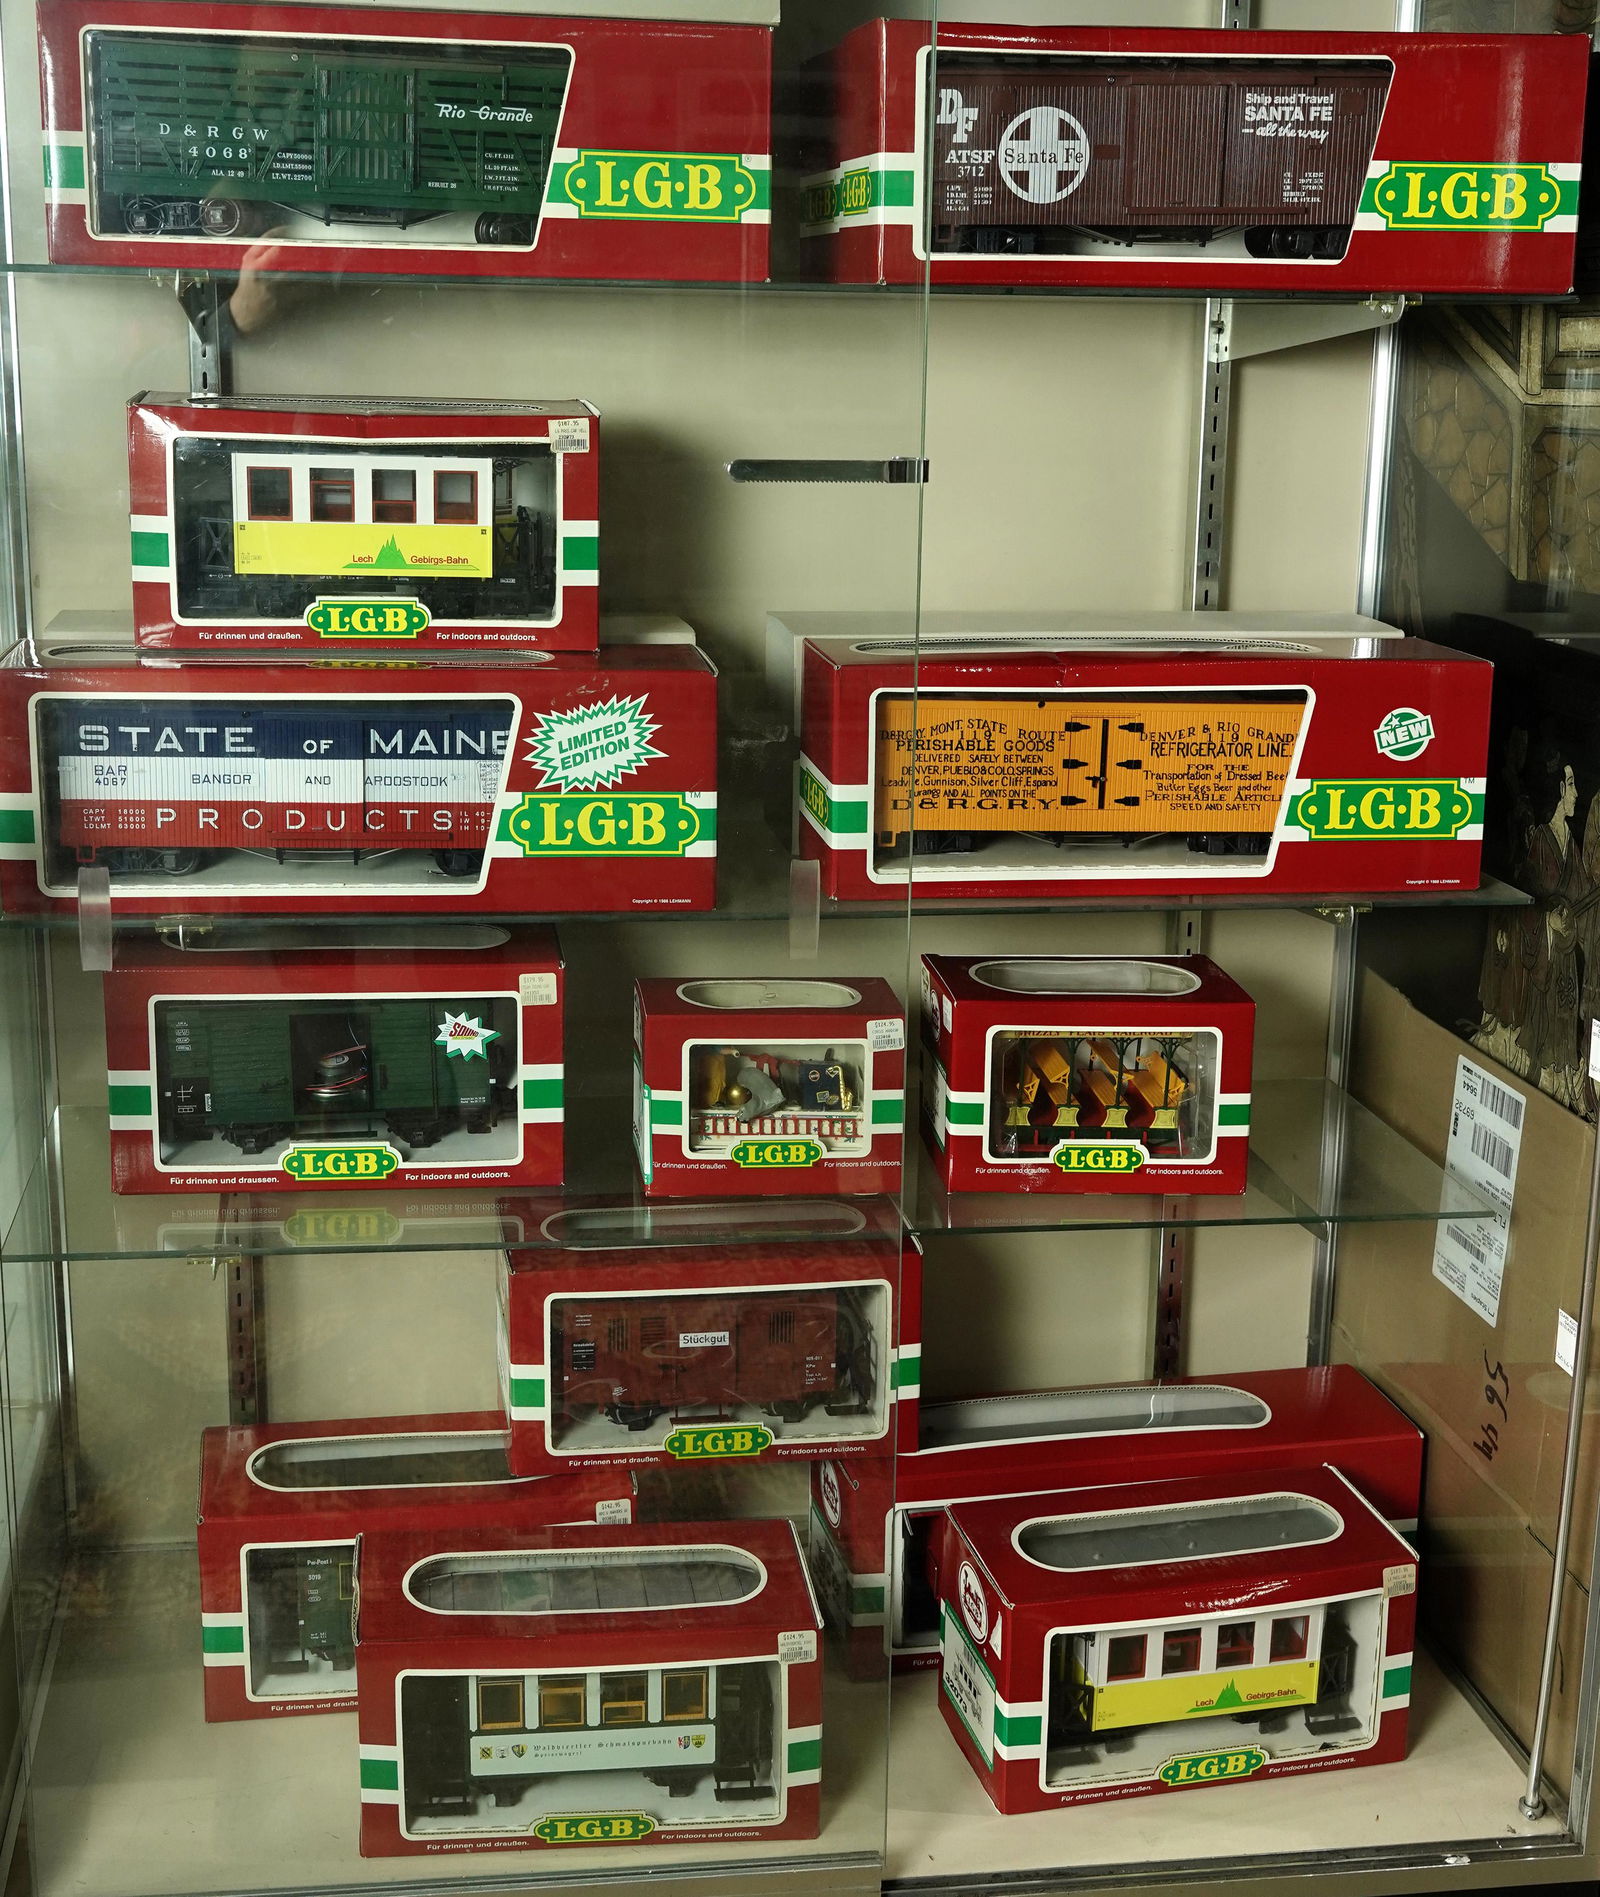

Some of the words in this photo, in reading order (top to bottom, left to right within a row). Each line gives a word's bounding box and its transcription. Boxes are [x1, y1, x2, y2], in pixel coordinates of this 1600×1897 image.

[1246, 93, 1272, 106] Ship
[1274, 94, 1296, 104] and
[1298, 93, 1334, 104] Travel
[434, 103, 466, 118] Rio
[470, 105, 533, 122] Grande
[1245, 106, 1305, 121] SANTA
[1310, 106, 1333, 121] FE
[1256, 122, 1278, 137] all
[1278, 122, 1297, 137] the
[1298, 129, 1330, 144] way
[945, 149, 996, 164] ATSF
[1004, 147, 1058, 164] Santa
[1064, 147, 1084, 164] Fe
[957, 165, 985, 178] 3712
[352, 554, 374, 564] Lech
[410, 555, 469, 566] Gebirgs-Bahn
[199, 632, 213, 640] Für
[215, 632, 247, 640] drinnen
[249, 632, 265, 640] und
[267, 632, 303, 640] draußen.
[436, 632, 450, 640] For
[452, 632, 482, 640] indoors
[483, 632, 499, 641] and
[500, 633, 538, 641] outdoors.
[967, 718, 1007, 735] STATE
[1018, 728, 1066, 742] ROUTE
[1140, 727, 1196, 742] DENVER
[1202, 723, 1211, 734] &
[1217, 721, 1241, 733] RIO
[1379, 720, 1428, 748] NEW
[79, 725, 256, 753] STATE
[303, 739, 334, 755] OF
[370, 728, 507, 755] MAINE
[558, 721, 627, 755] LIMITED
[896, 739, 996, 752] PERISHABLE
[1004, 740, 1055, 752] GOODS
[1150, 742, 1253, 758] REFRIGERATOR
[560, 737, 630, 771] EDITION
[968, 754, 1000, 763] SAFELY
[1003, 754, 1044, 763] BETWEEN
[94, 765, 128, 776] BAR
[1187, 763, 1214, 771] FOR
[1223, 763, 1250, 771] THE
[94, 777, 127, 786] 4067
[191, 774, 252, 785] BANGOR
[305, 775, 331, 785] AND
[364, 776, 449, 787] AROOSTOOK
[970, 775, 999, 787] Silver
[1143, 770, 1215, 784] Transportation
[1215, 771, 1223, 782] of
[1227, 770, 1262, 781] Dressed
[943, 789, 959, 798] AND
[961, 789, 975, 798] ALL
[980, 789, 1007, 798] POINTS
[1008, 789, 1020, 798] ON
[1021, 789, 1036, 798] THE
[1156, 783, 1186, 791] Butter
[1188, 782, 1211, 794] Eggs
[1213, 783, 1233, 791] Beer
[1237, 783, 1251, 791] and
[1252, 783, 1272, 791] other
[1169, 803, 1202, 811] SPEED
[1204, 803, 1223, 811] AND
[1225, 803, 1261, 811] SAFETY
[156, 807, 453, 832] PRODUCTS
[449, 1021, 480, 1038] SOUND
[700, 1162, 727, 1170] draußen.
[872, 1160, 903, 1168] outdoors.
[170, 1177, 184, 1185] Für
[185, 1177, 219, 1185] drinnen
[220, 1177, 237, 1185] und
[238, 1176, 280, 1184] draussen.
[405, 1173, 419, 1181] For
[420, 1172, 453, 1181] indoors
[454, 1172, 469, 1180] and
[471, 1171, 511, 1180] outdoors.
[683, 1334, 727, 1345] Stückgut
[790, 1447, 817, 1455] indoors
[818, 1446, 833, 1454] and
[833, 1445, 867, 1453] outdoors.
[569, 1459, 581, 1467] Für
[583, 1458, 611, 1466] drinnen
[612, 1457, 627, 1465] und
[629, 1455, 661, 1464] draußen.
[945, 1671, 968, 1714] 32073
[1195, 1698, 1214, 1708] Lech
[1246, 1688, 1297, 1700] Gebirgs-Bahn
[285, 1703, 315, 1711] drinnen
[1281, 1764, 1309, 1772] indoors
[1309, 1761, 1323, 1769] and
[1323, 1758, 1356, 1767] outdoors.
[1061, 1794, 1074, 1802] Für
[1075, 1791, 1103, 1800] drinnen
[1105, 1789, 1120, 1797] und
[1121, 1785, 1153, 1795] draußen.
[724, 1830, 762, 1838] outdoors.
[427, 1843, 441, 1851] Für
[442, 1842, 474, 1850] drinnen
[476, 1841, 492, 1849] und
[494, 1840, 530, 1848] draußen.
